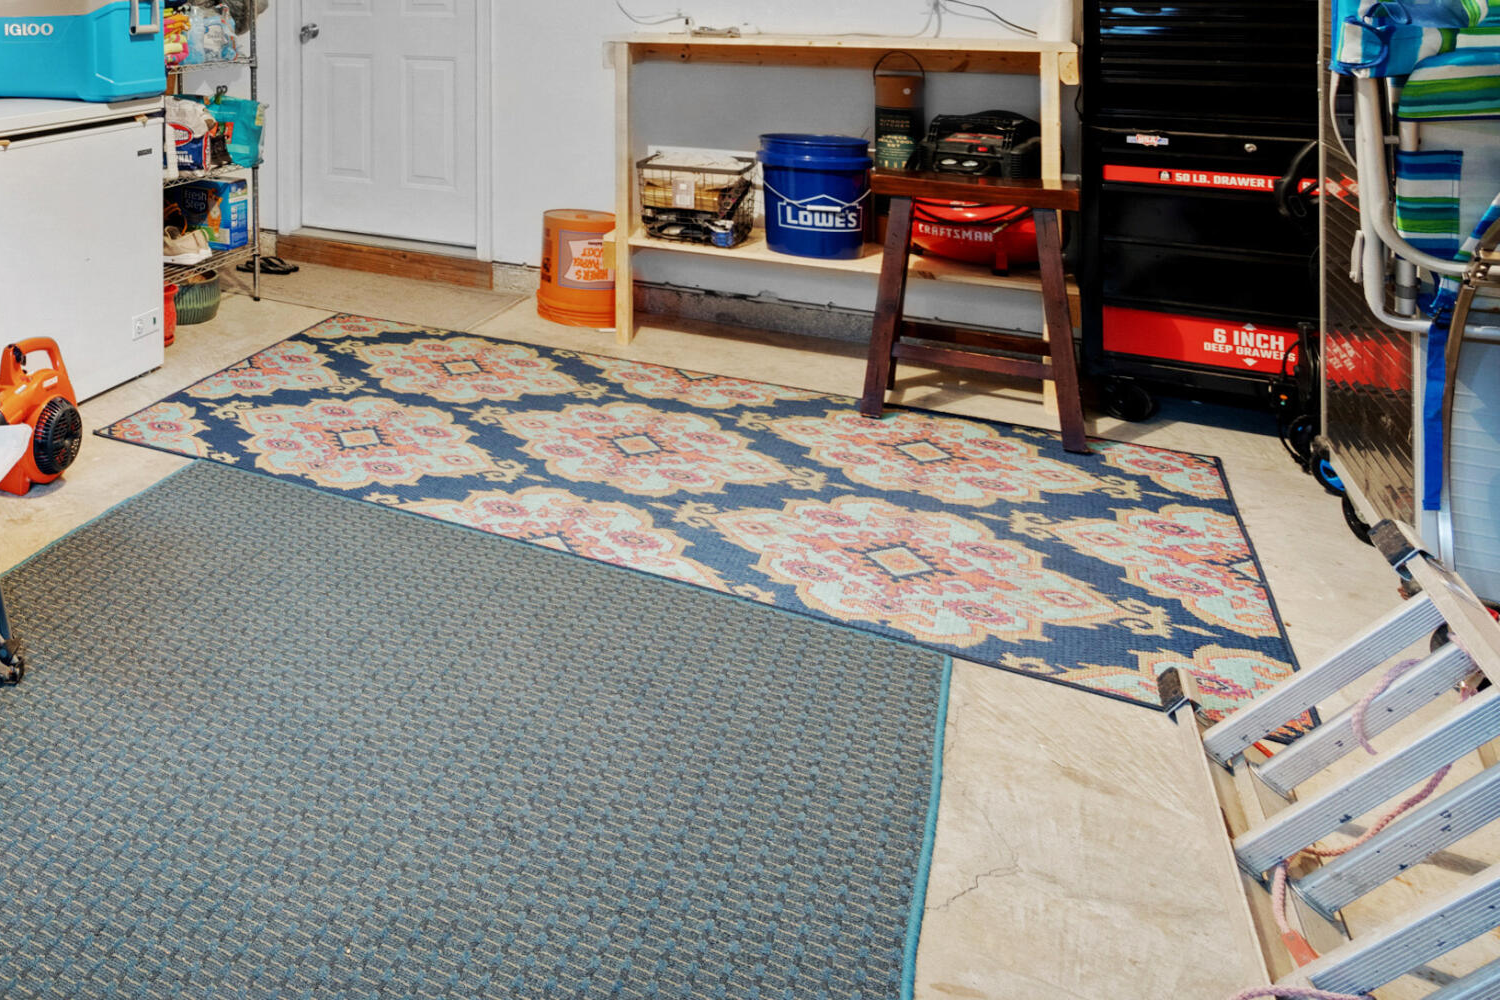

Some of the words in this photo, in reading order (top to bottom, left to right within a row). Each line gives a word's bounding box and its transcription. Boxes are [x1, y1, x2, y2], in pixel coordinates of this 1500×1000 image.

[3, 22, 54, 37] IGLOO
[1174, 172, 1191, 182] 50
[1192, 173, 1211, 184] LB.
[1213, 175, 1265, 188] DRAWER
[184, 189, 207, 201] Fresh
[185, 200, 206, 211] Step
[918, 223, 994, 242] CRAFTSMAN
[1203, 341, 1233, 354] DEEP
[1213, 328, 1227, 344] 6
[1233, 330, 1285, 352] INCH
